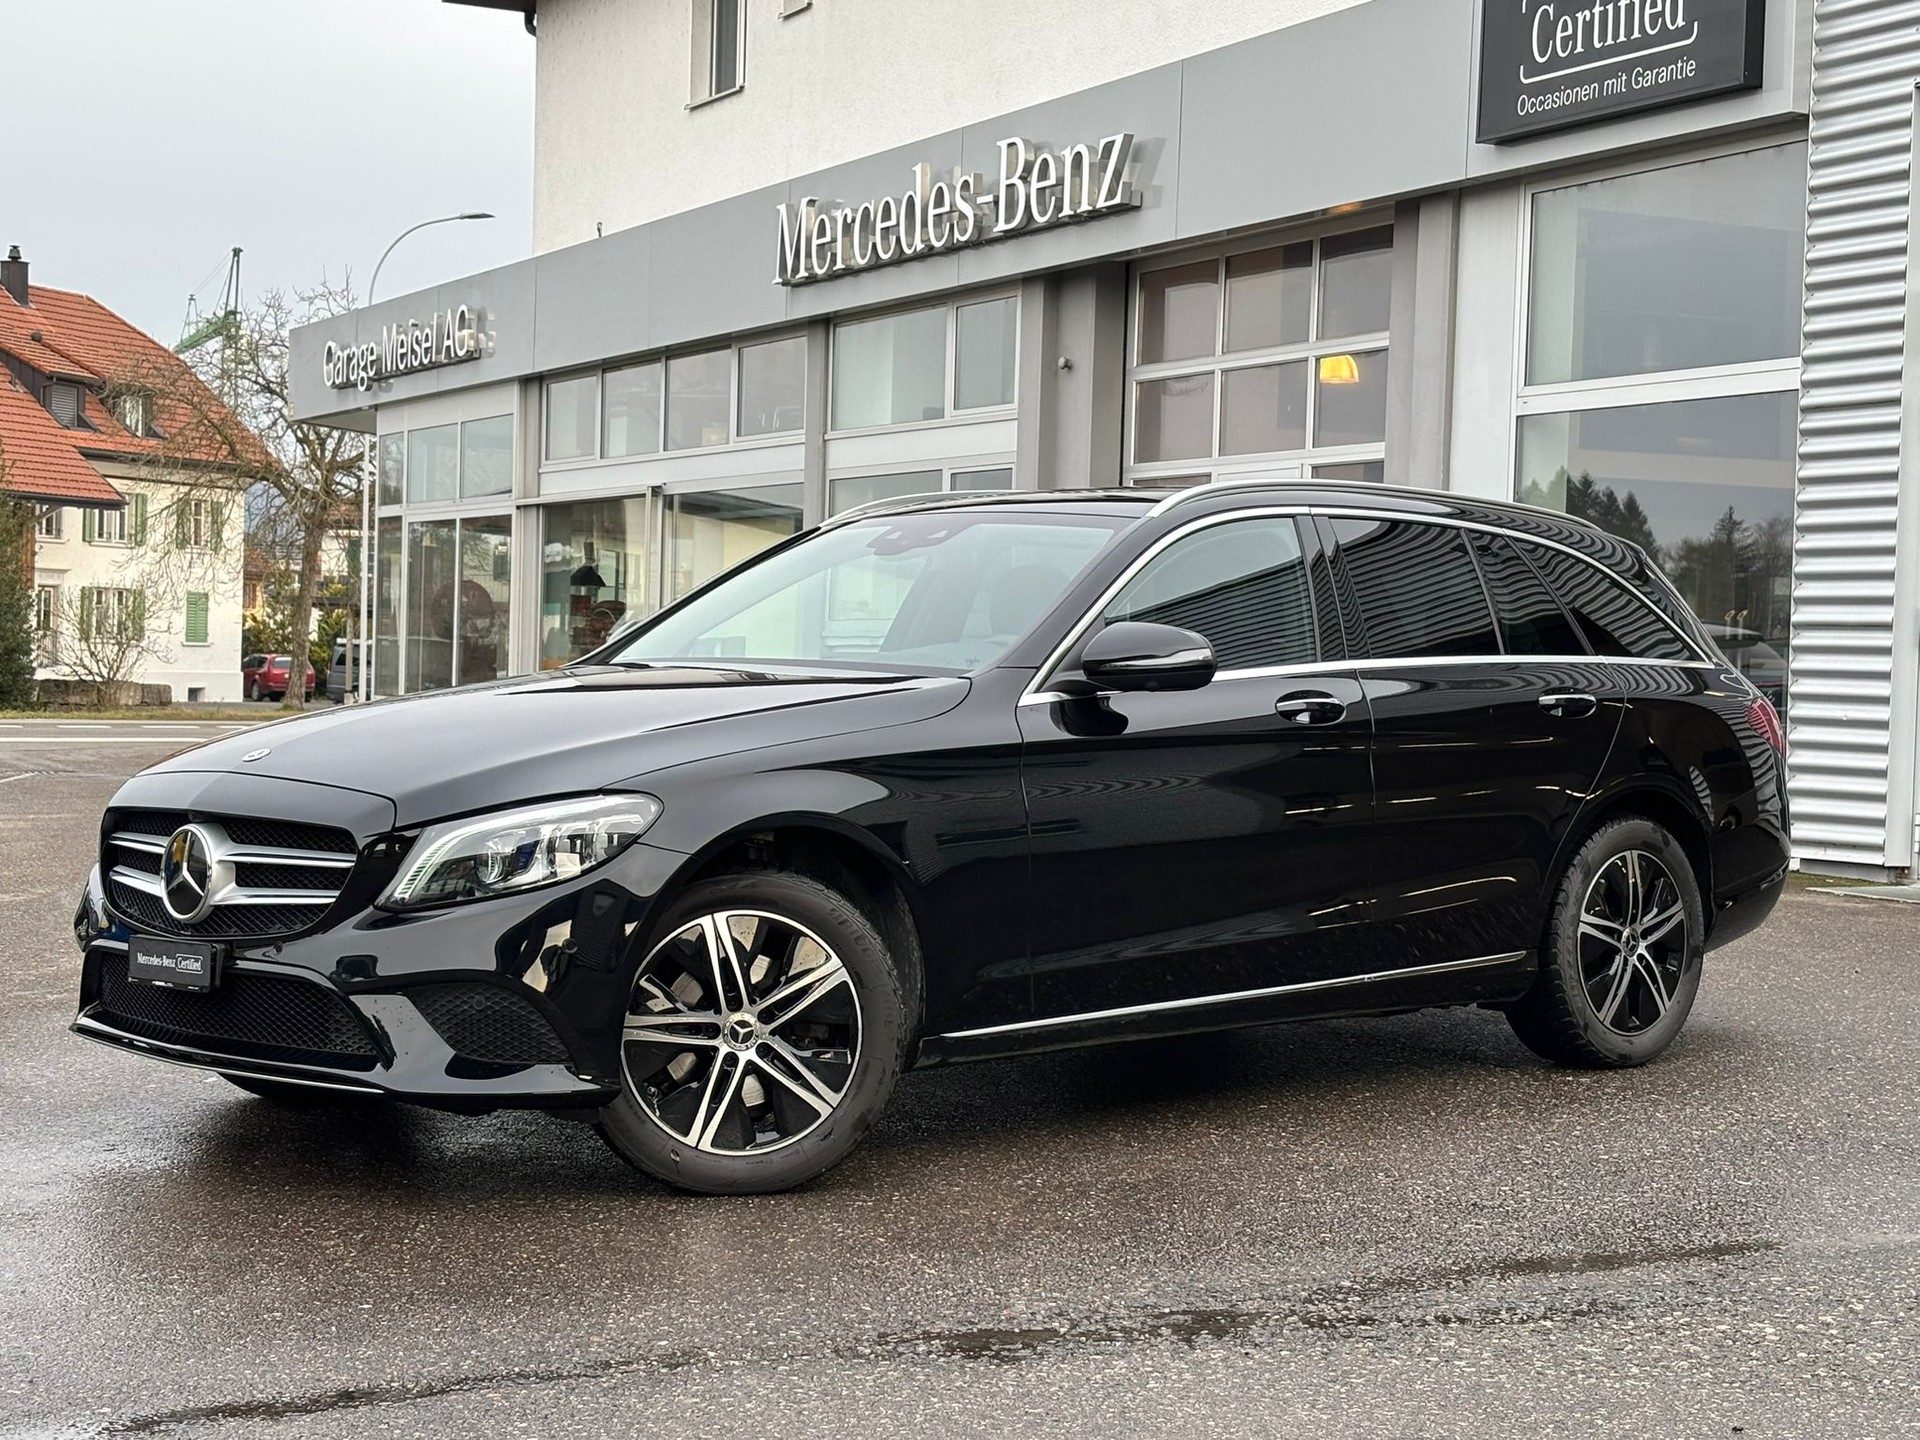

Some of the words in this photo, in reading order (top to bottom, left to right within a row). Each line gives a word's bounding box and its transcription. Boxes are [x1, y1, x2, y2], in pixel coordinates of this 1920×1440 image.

[1517, 82, 1599, 116] Occasionen
[1602, 71, 1627, 96] mit
[1631, 56, 1696, 90] Garantie
[772, 133, 1136, 285] Mercedes-Benz
[323, 340, 377, 392] Garage
[382, 312, 438, 374] Meisel
[441, 304, 469, 360] AG
[137, 952, 176, 968] Mercedes-Benz
[177, 957, 202, 971] Certified
